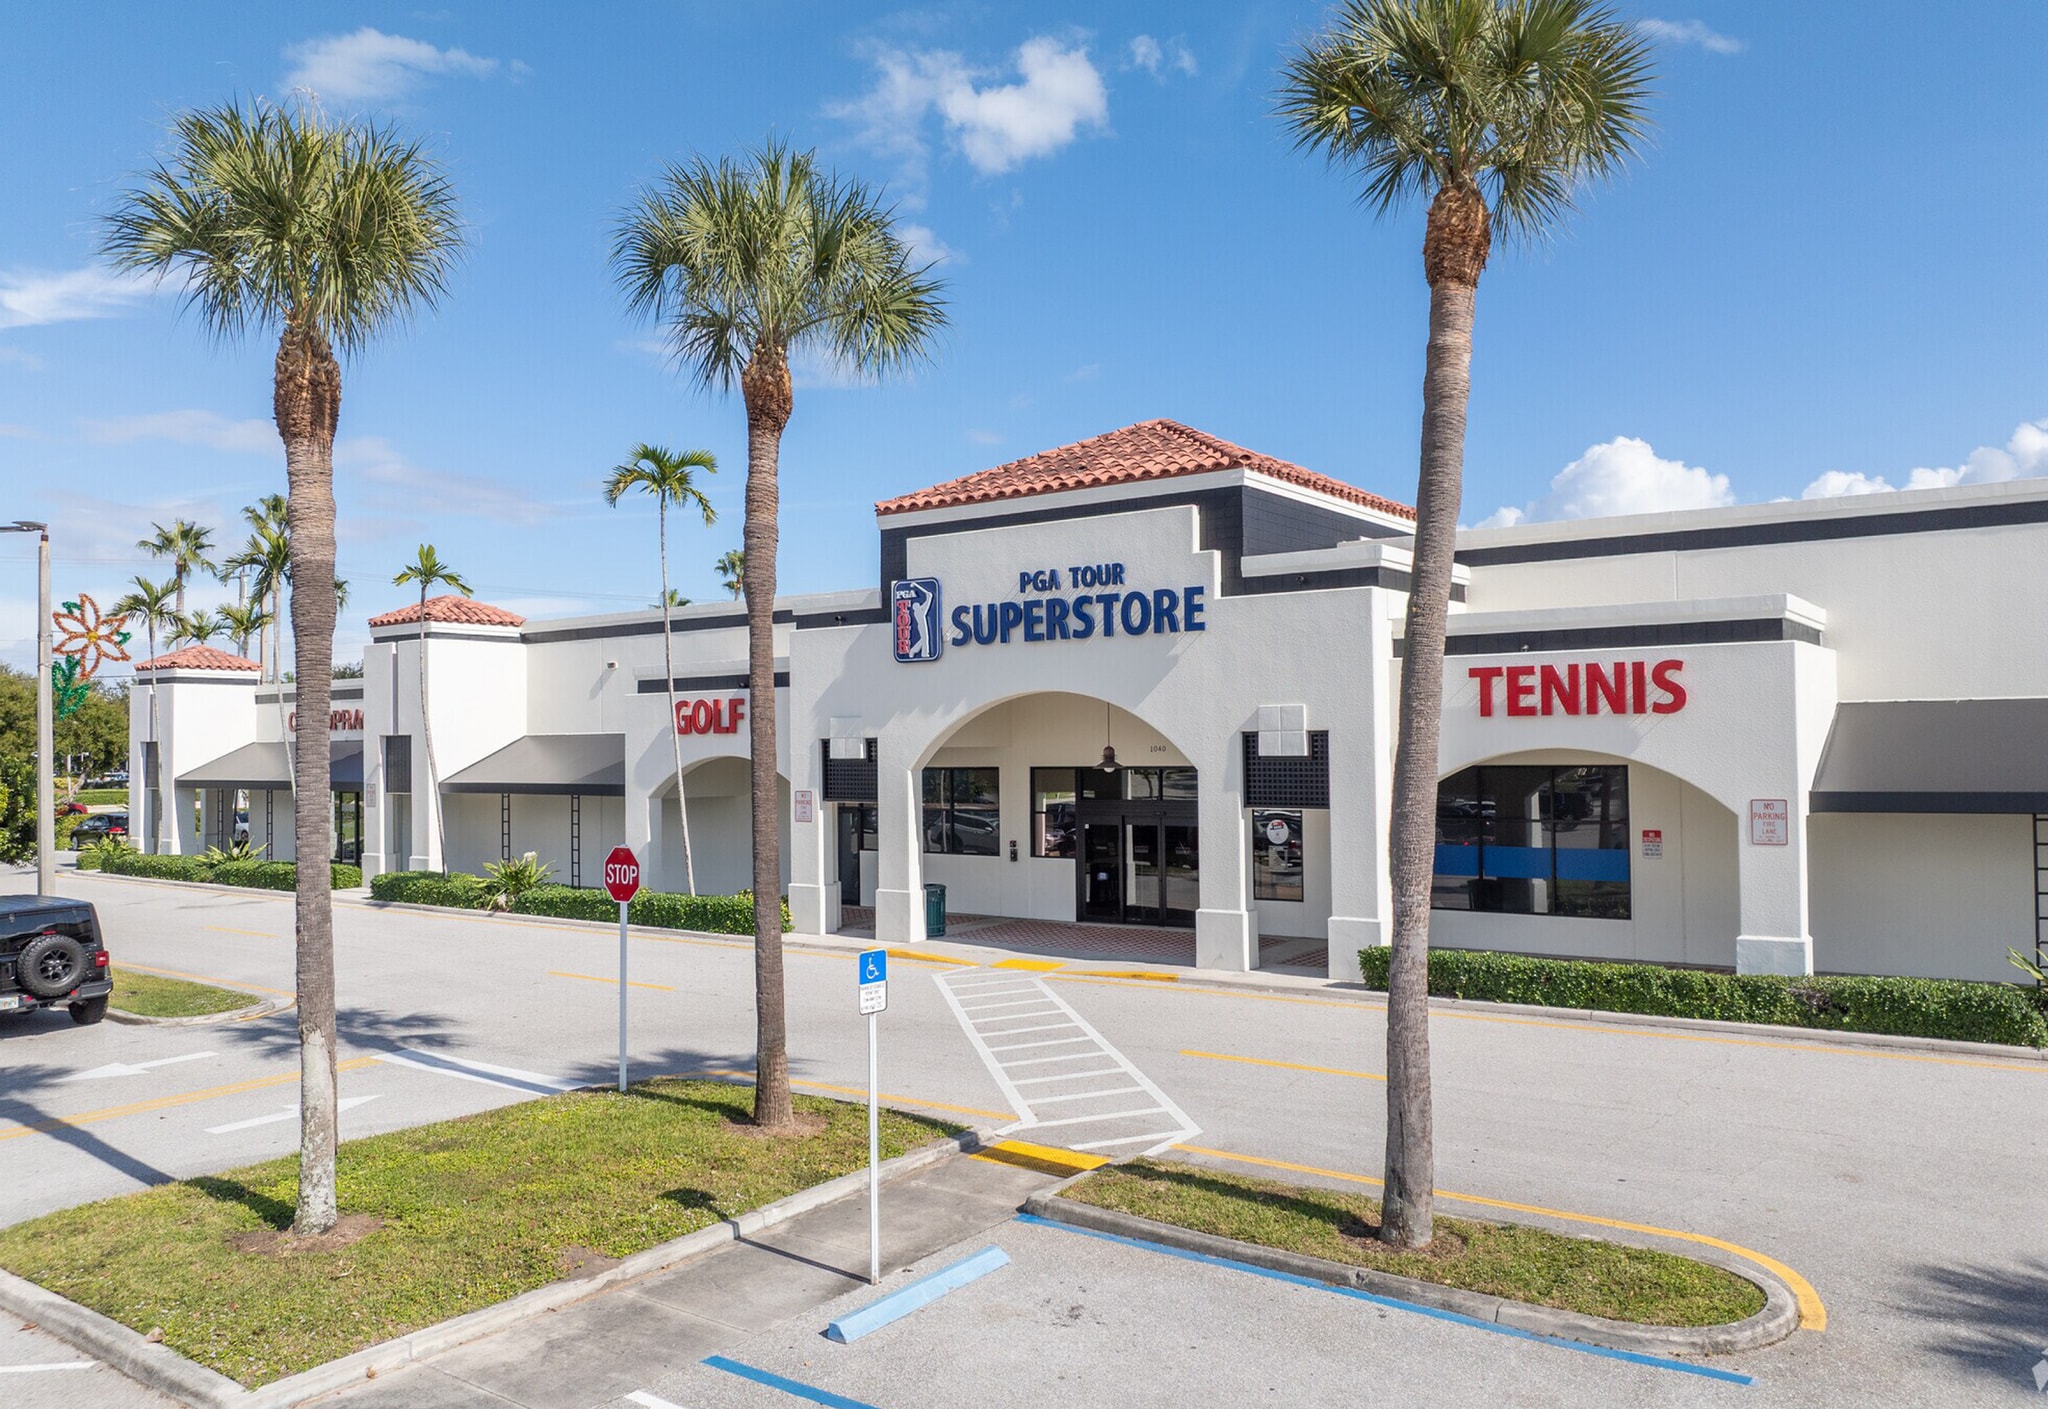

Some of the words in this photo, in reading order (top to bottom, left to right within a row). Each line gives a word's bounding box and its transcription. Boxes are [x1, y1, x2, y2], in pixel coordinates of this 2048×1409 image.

[1019, 569, 1059, 593] PGA
[1069, 562, 1125, 587] TOUR
[896, 590, 917, 599] PGA
[896, 601, 912, 654] TOUR
[951, 586, 1206, 647] SUPERSTORE
[1469, 659, 1687, 717] TENNIS
[675, 698, 745, 734] GOLF
[1753, 812, 1785, 820] PARKING
[1763, 802, 1775, 811] NO
[606, 863, 638, 885] STOP
